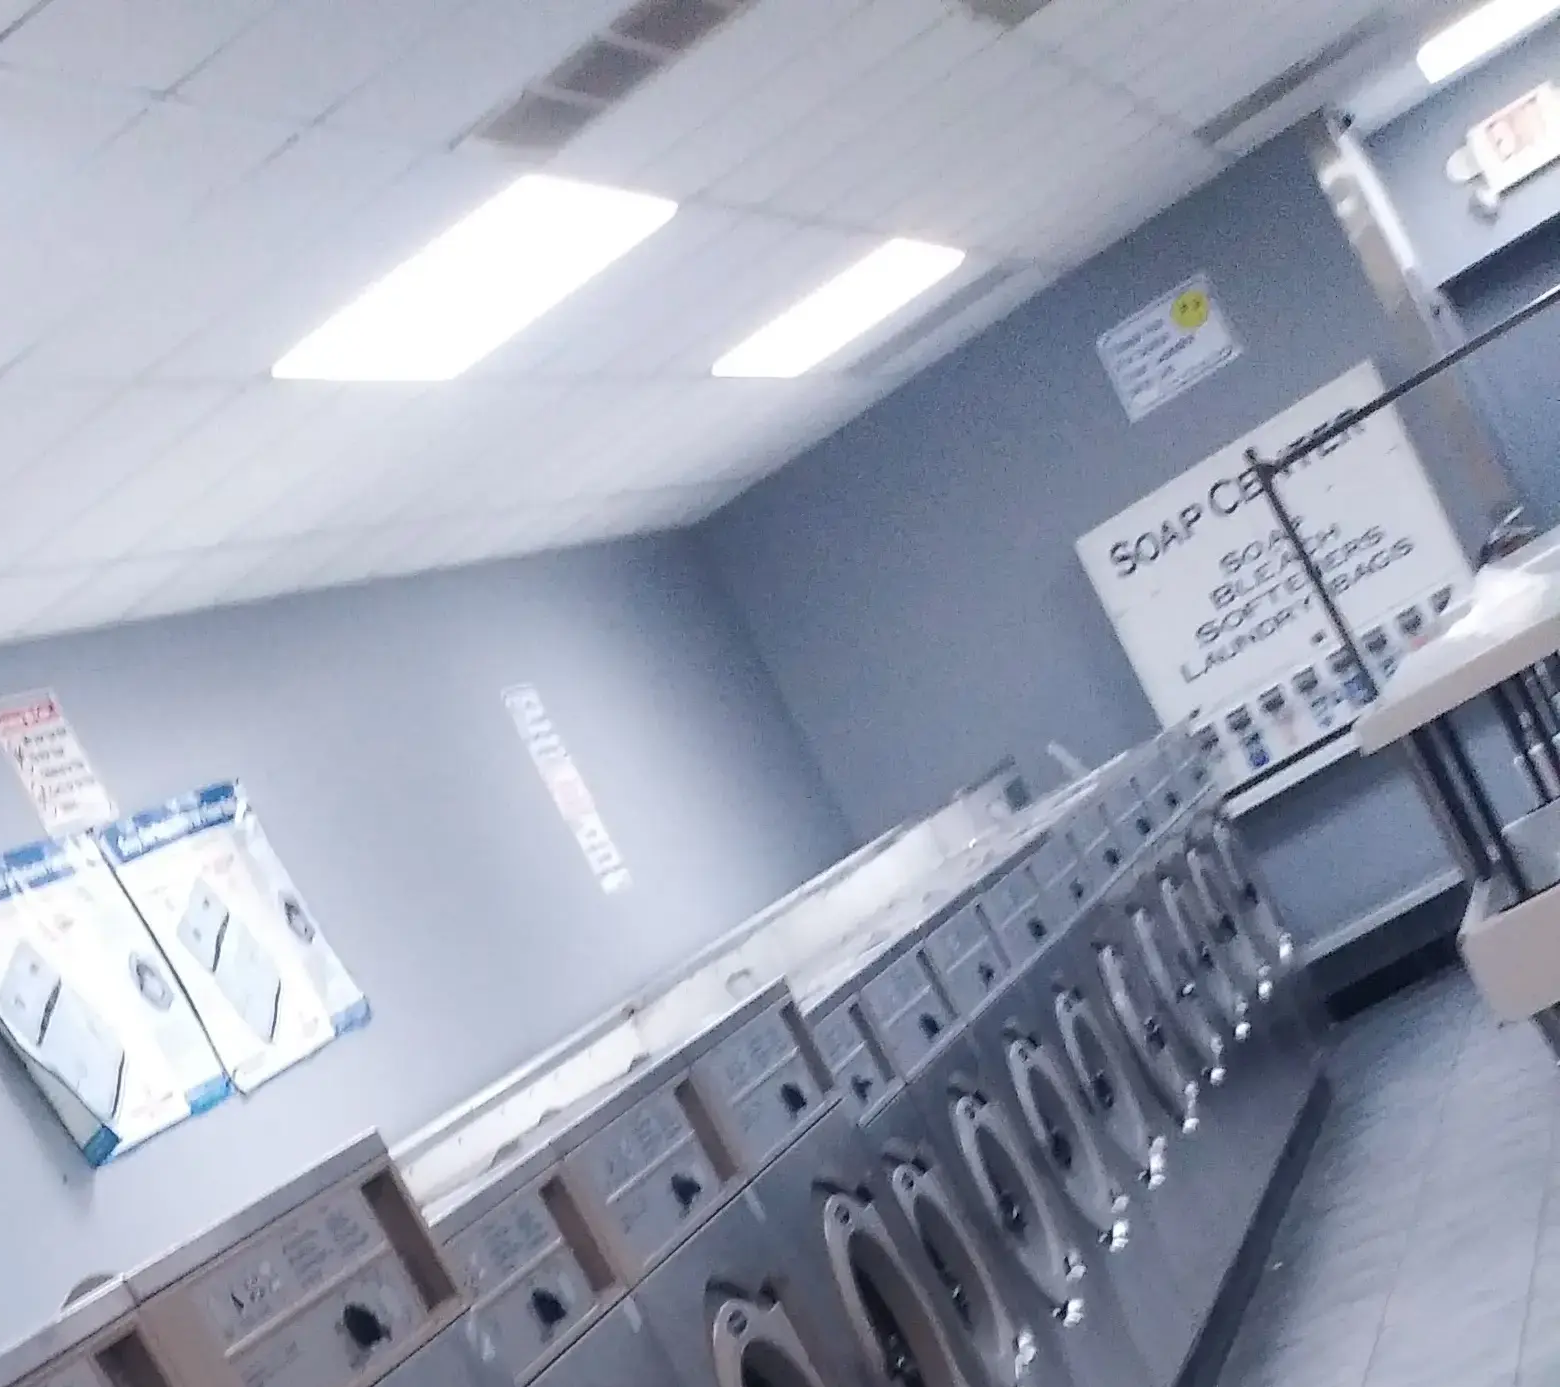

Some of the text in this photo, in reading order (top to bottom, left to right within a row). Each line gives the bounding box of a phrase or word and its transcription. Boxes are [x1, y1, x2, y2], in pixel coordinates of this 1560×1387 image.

[1104, 494, 1211, 580] SOAP
[1178, 534, 1418, 684] LAUNDRY BAGS
